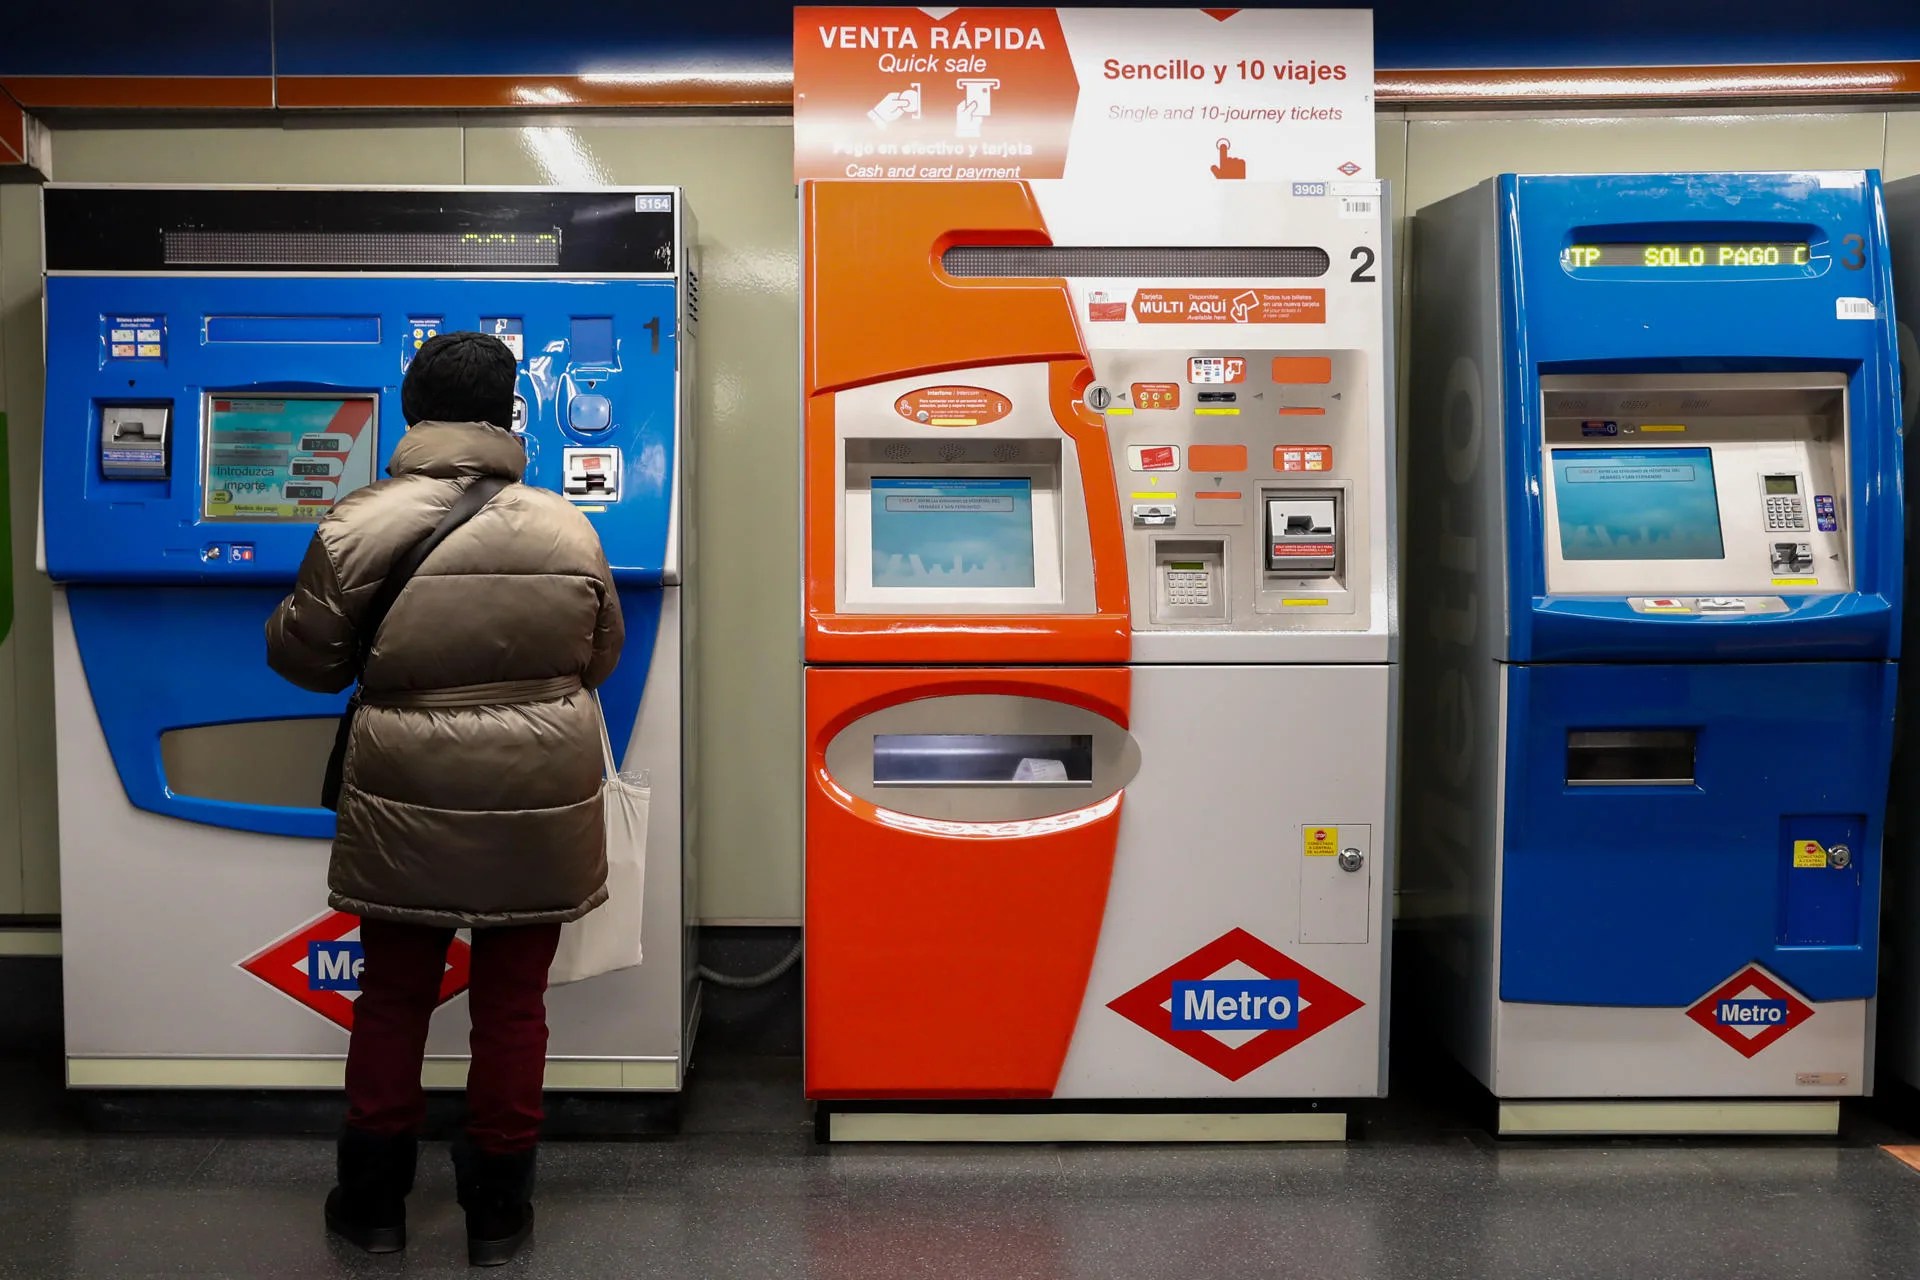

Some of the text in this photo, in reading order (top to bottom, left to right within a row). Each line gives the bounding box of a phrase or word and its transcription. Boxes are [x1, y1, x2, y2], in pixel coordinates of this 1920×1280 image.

[818, 22, 1046, 50] VENTA RÁPIDA
[878, 53, 987, 73] Quick sale
[1103, 58, 1347, 85] Sencillo y 10 viajes
[1108, 105, 1343, 124] Single and 10-journey tickets
[877, 144, 897, 155] en
[902, 142, 965, 155] efectivo
[981, 142, 1033, 158] tarjeta
[845, 163, 1021, 179] Cash and card payment
[1294, 184, 1324, 195] 3908
[1645, 247, 1705, 267] SOLO
[1719, 246, 1779, 266] PAGO
[1841, 233, 1866, 271] 3
[1349, 245, 1376, 283] 2
[1139, 298, 1227, 314] MULTI AQUÍ
[643, 316, 660, 354] 1
[216, 465, 275, 477] Introduzca
[223, 480, 267, 493] importe
[1184, 989, 1292, 1021] Metro
[1721, 1003, 1782, 1022] Metro
